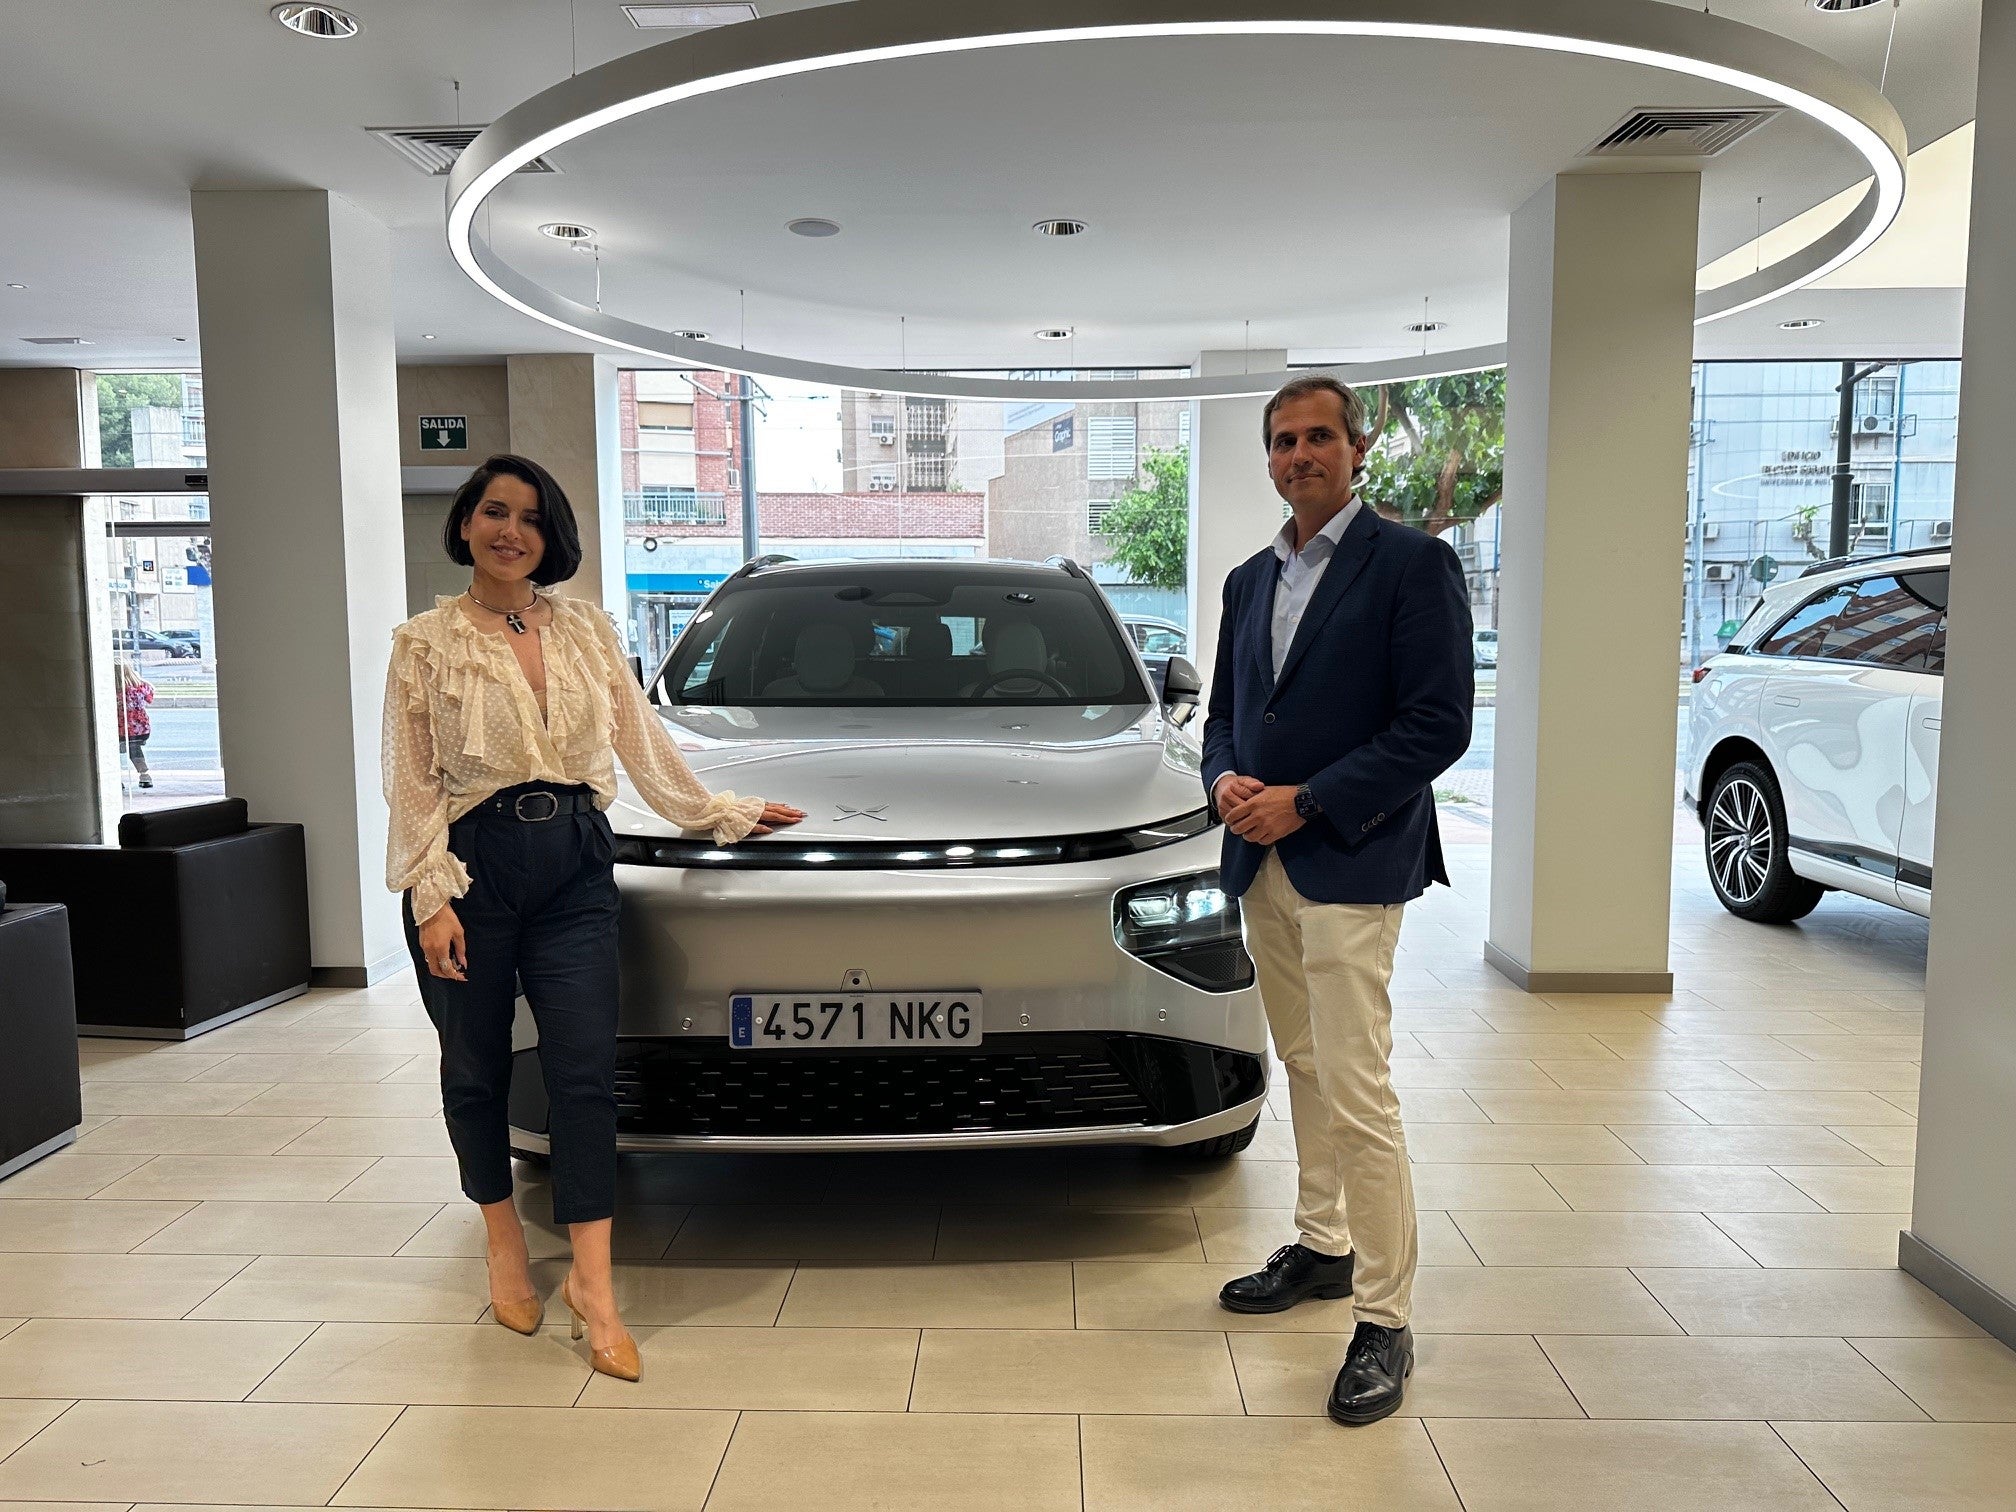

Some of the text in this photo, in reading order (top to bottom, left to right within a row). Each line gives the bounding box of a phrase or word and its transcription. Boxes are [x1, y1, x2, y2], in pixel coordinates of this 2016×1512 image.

[421, 418, 465, 429] SALIDA
[763, 1001, 970, 1041] 4571 NKG
[738, 1027, 746, 1038] E
